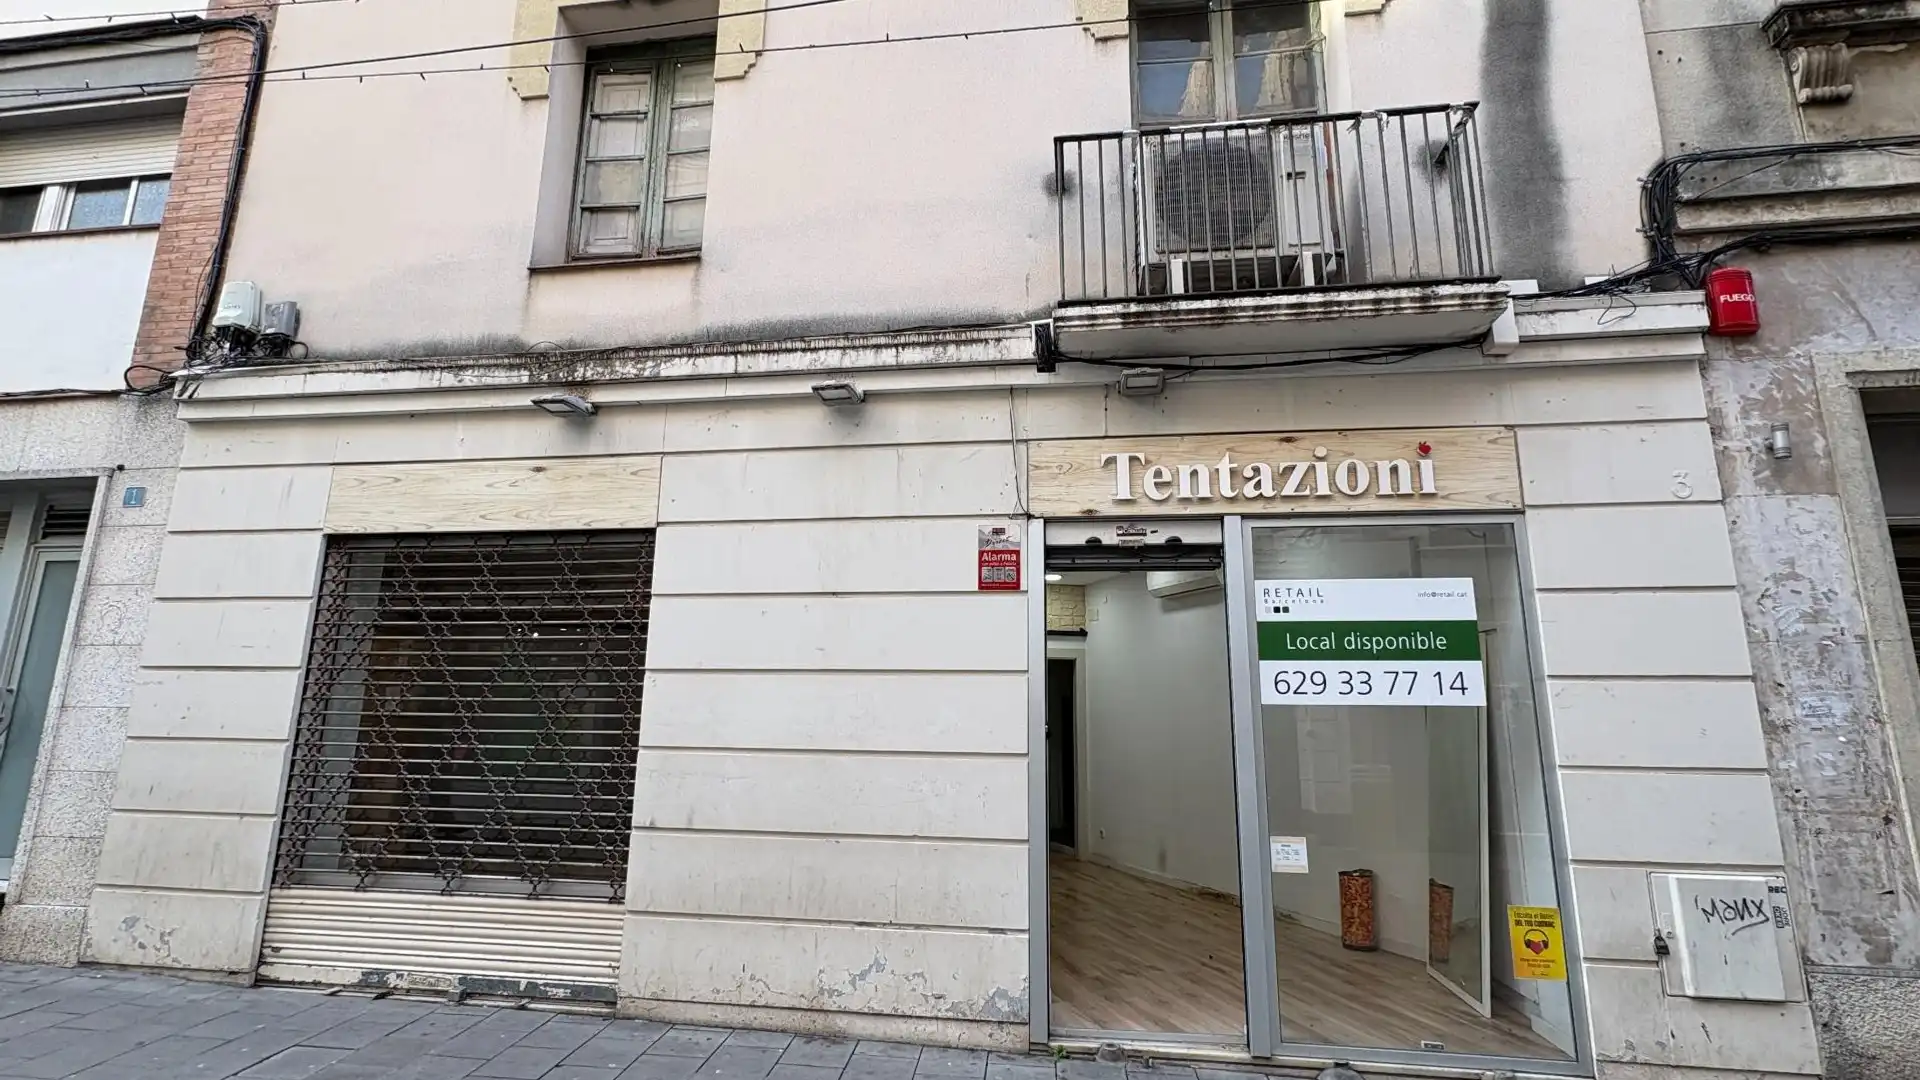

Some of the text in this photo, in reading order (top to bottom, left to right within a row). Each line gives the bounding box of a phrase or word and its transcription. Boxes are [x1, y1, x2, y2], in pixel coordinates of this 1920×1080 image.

[1720, 293, 1755, 303] FUEGO
[1101, 441, 1439, 501] Tentazioni
[1671, 470, 1693, 499] 3
[981, 552, 1017, 561] Alarma
[1263, 587, 1324, 598] RETAIL
[1286, 631, 1447, 654] Local disponible
[1274, 670, 1468, 695] 629 33 77 14
